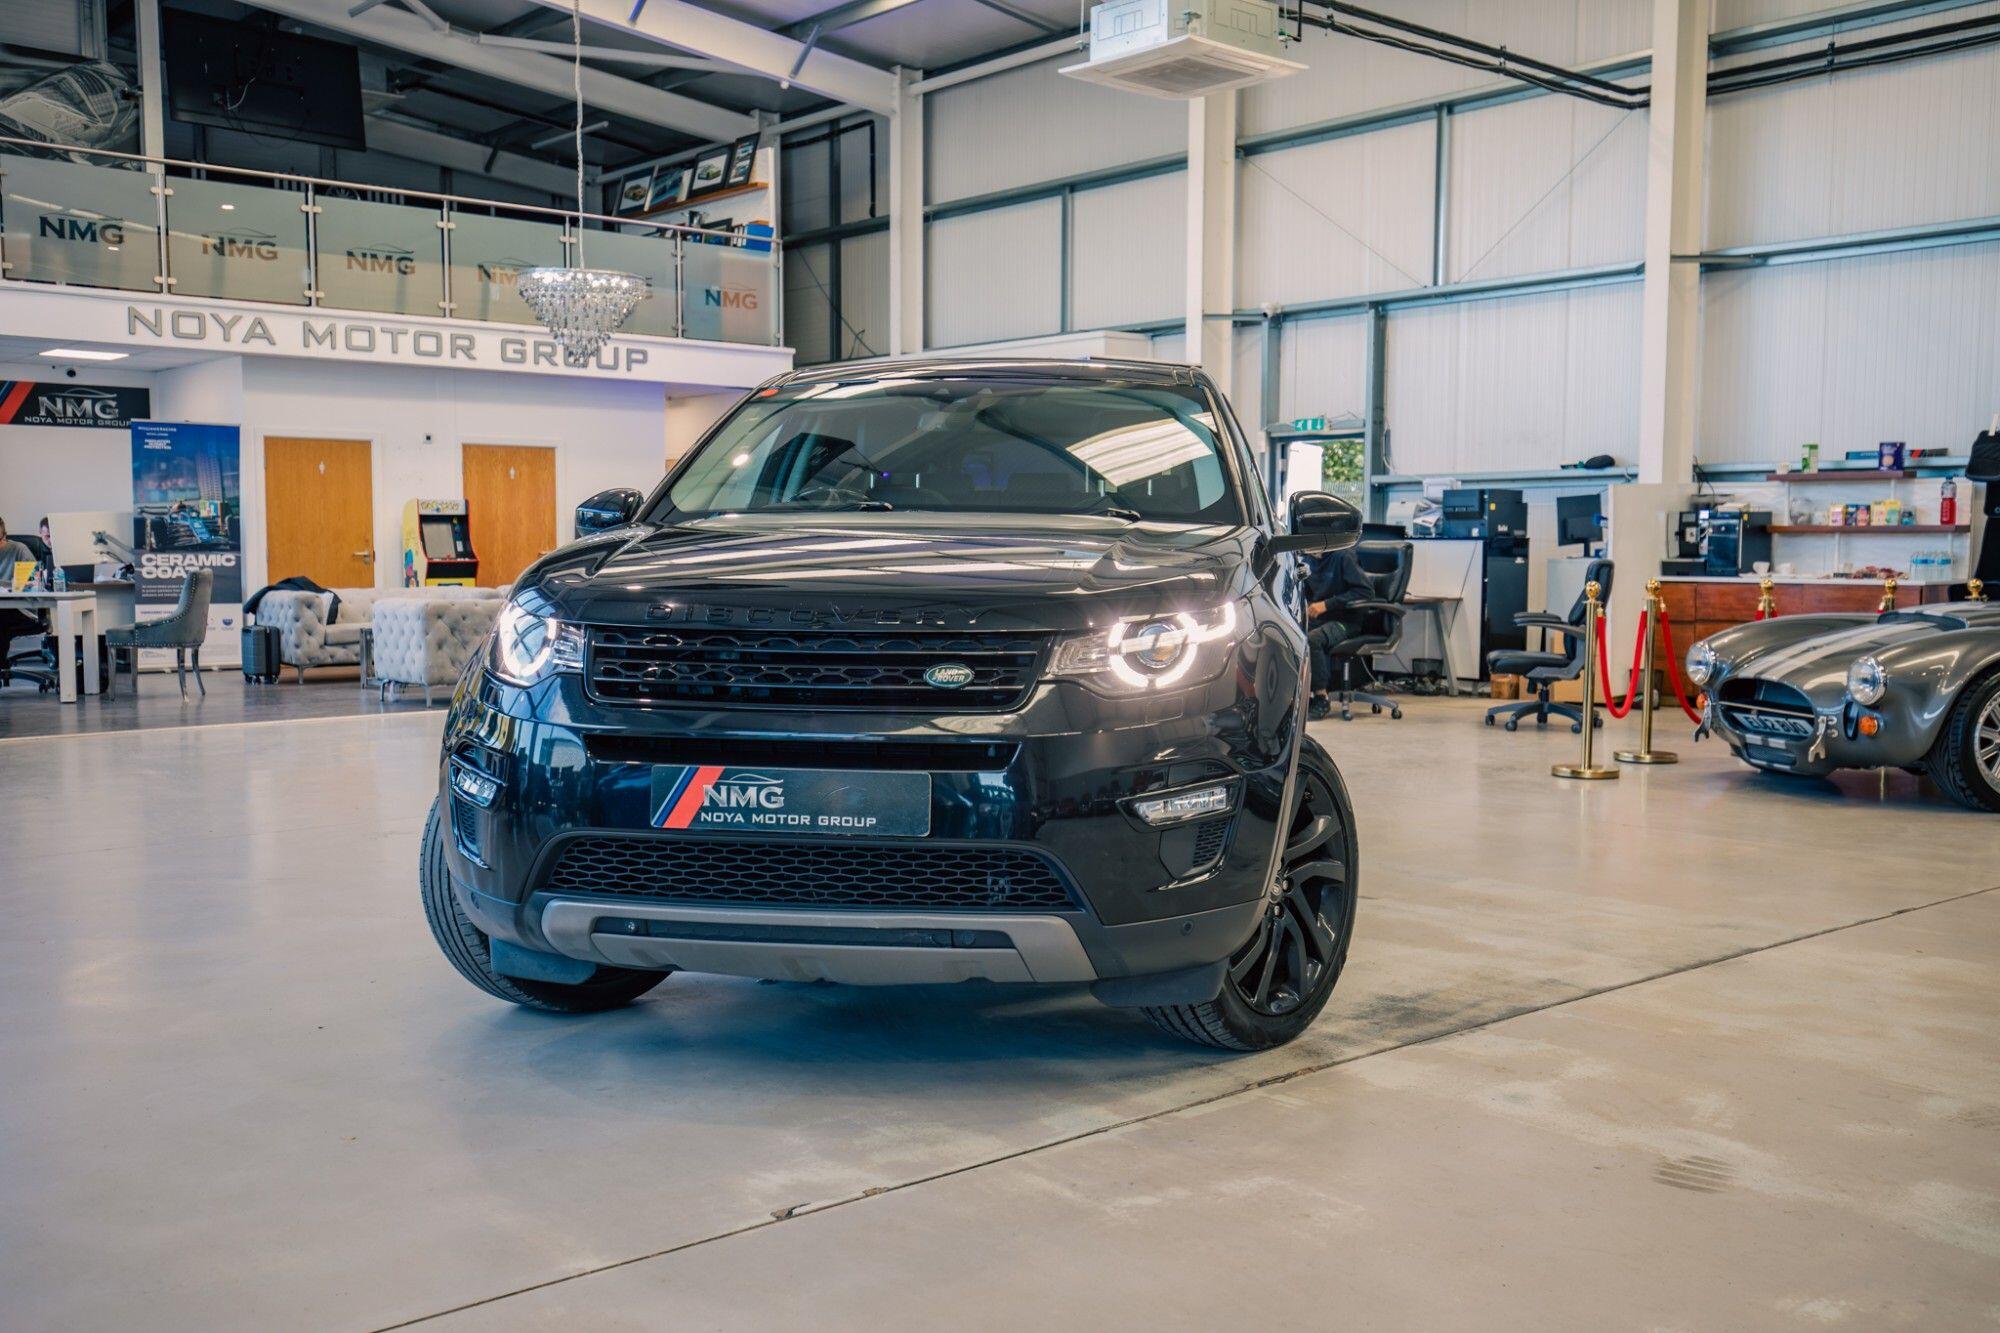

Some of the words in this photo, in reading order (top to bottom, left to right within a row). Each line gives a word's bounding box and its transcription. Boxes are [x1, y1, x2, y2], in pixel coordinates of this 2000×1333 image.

[39, 215, 125, 245] NMG
[201, 233, 279, 261] NMG
[346, 250, 416, 275] NMG
[704, 289, 758, 310] NMG
[127, 305, 277, 346] NOYA
[302, 320, 477, 361] MOTOR
[500, 337, 649, 372] GROUP
[38, 396, 119, 419] NMG
[24, 416, 54, 424] NOYA
[56, 417, 94, 426] MOTOR
[141, 553, 236, 567] CERAMIC
[645, 602, 992, 626] DISCOVERY
[934, 668, 960, 676] LAND
[937, 674, 965, 682] ROVER
[702, 784, 785, 809] NMG
[700, 812, 745, 823] NOYA
[752, 813, 811, 826] MOTOR
[817, 815, 877, 828] GROUP
